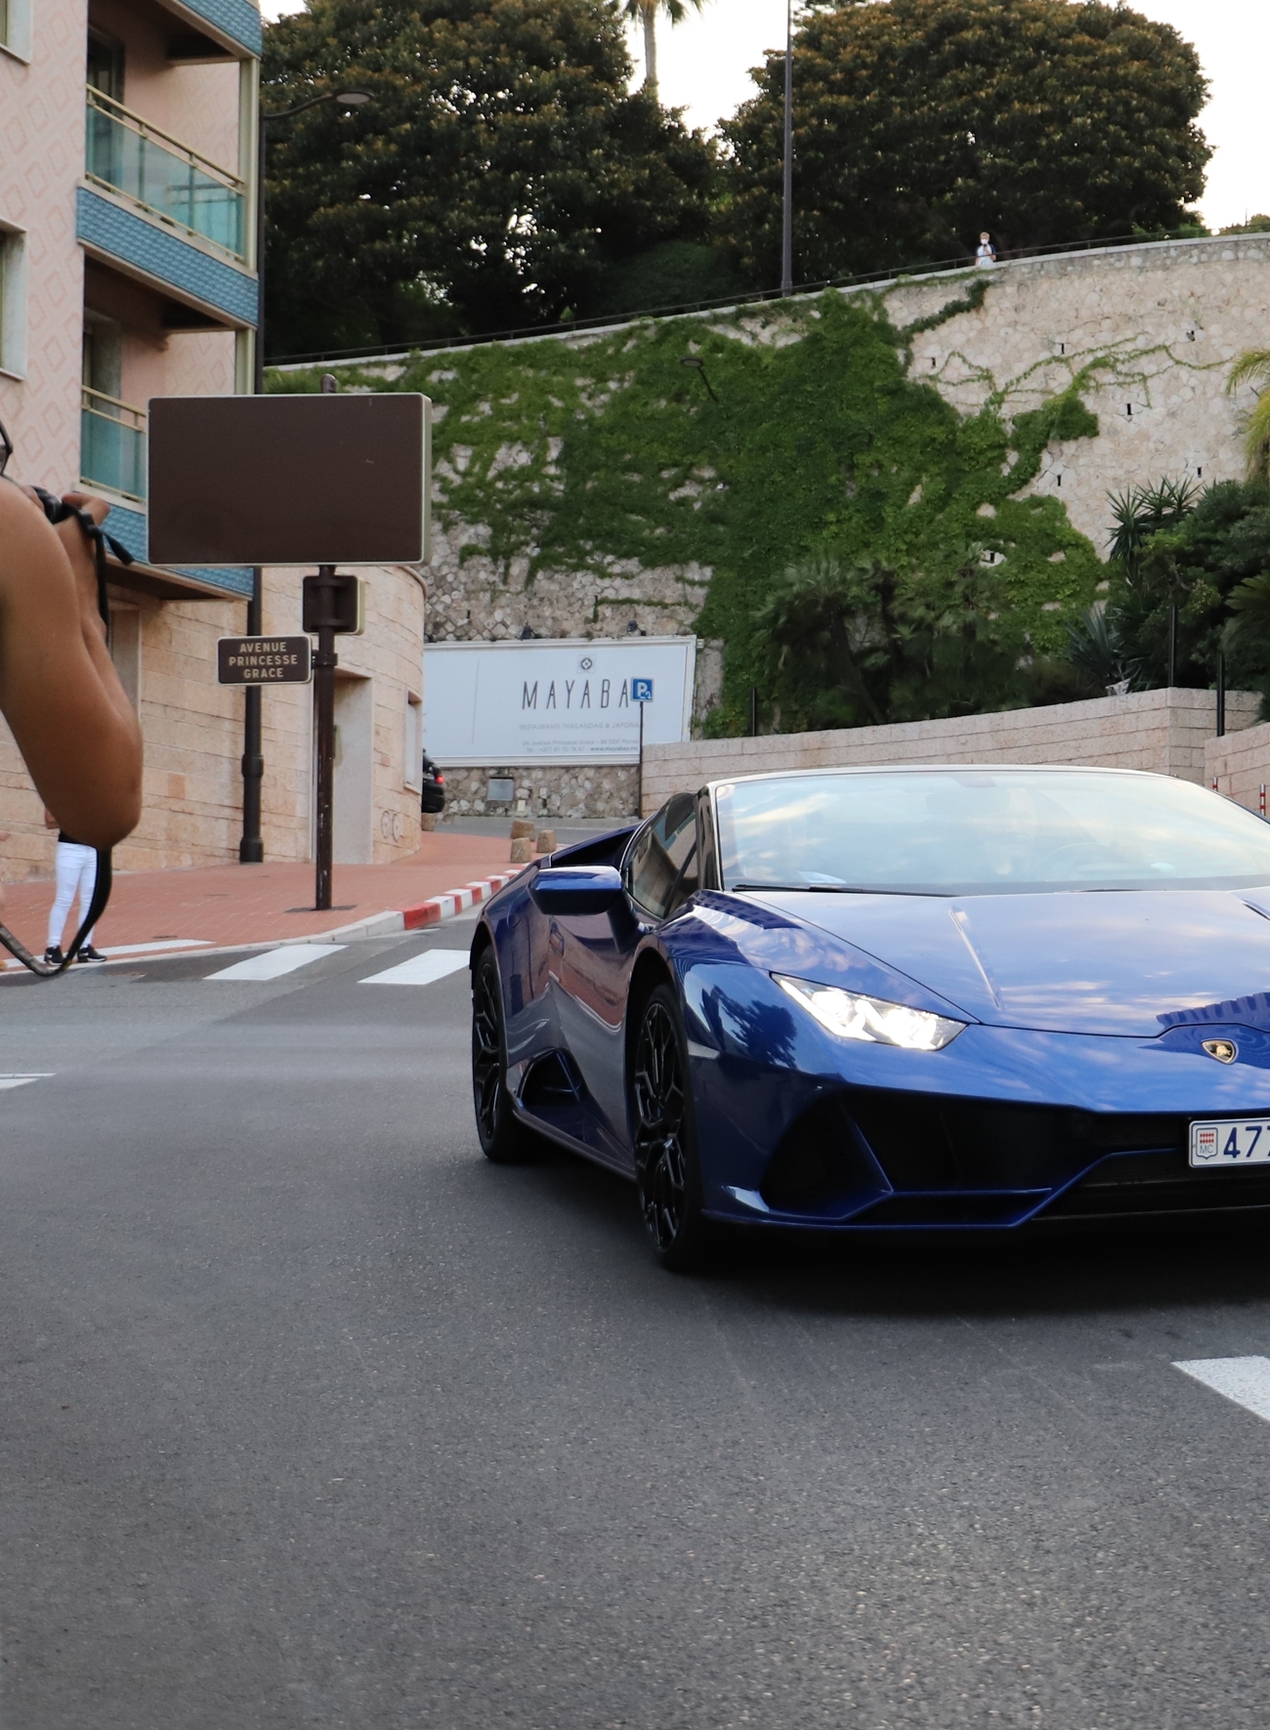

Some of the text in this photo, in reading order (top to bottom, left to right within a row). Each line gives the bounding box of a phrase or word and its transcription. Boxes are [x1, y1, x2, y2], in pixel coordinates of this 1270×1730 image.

[240, 642, 287, 653] AVENUE
[228, 655, 298, 666] PRINCESSE
[244, 668, 284, 679] GRACE
[522, 678, 630, 710] MAYABA
[612, 721, 641, 729] JAPONA
